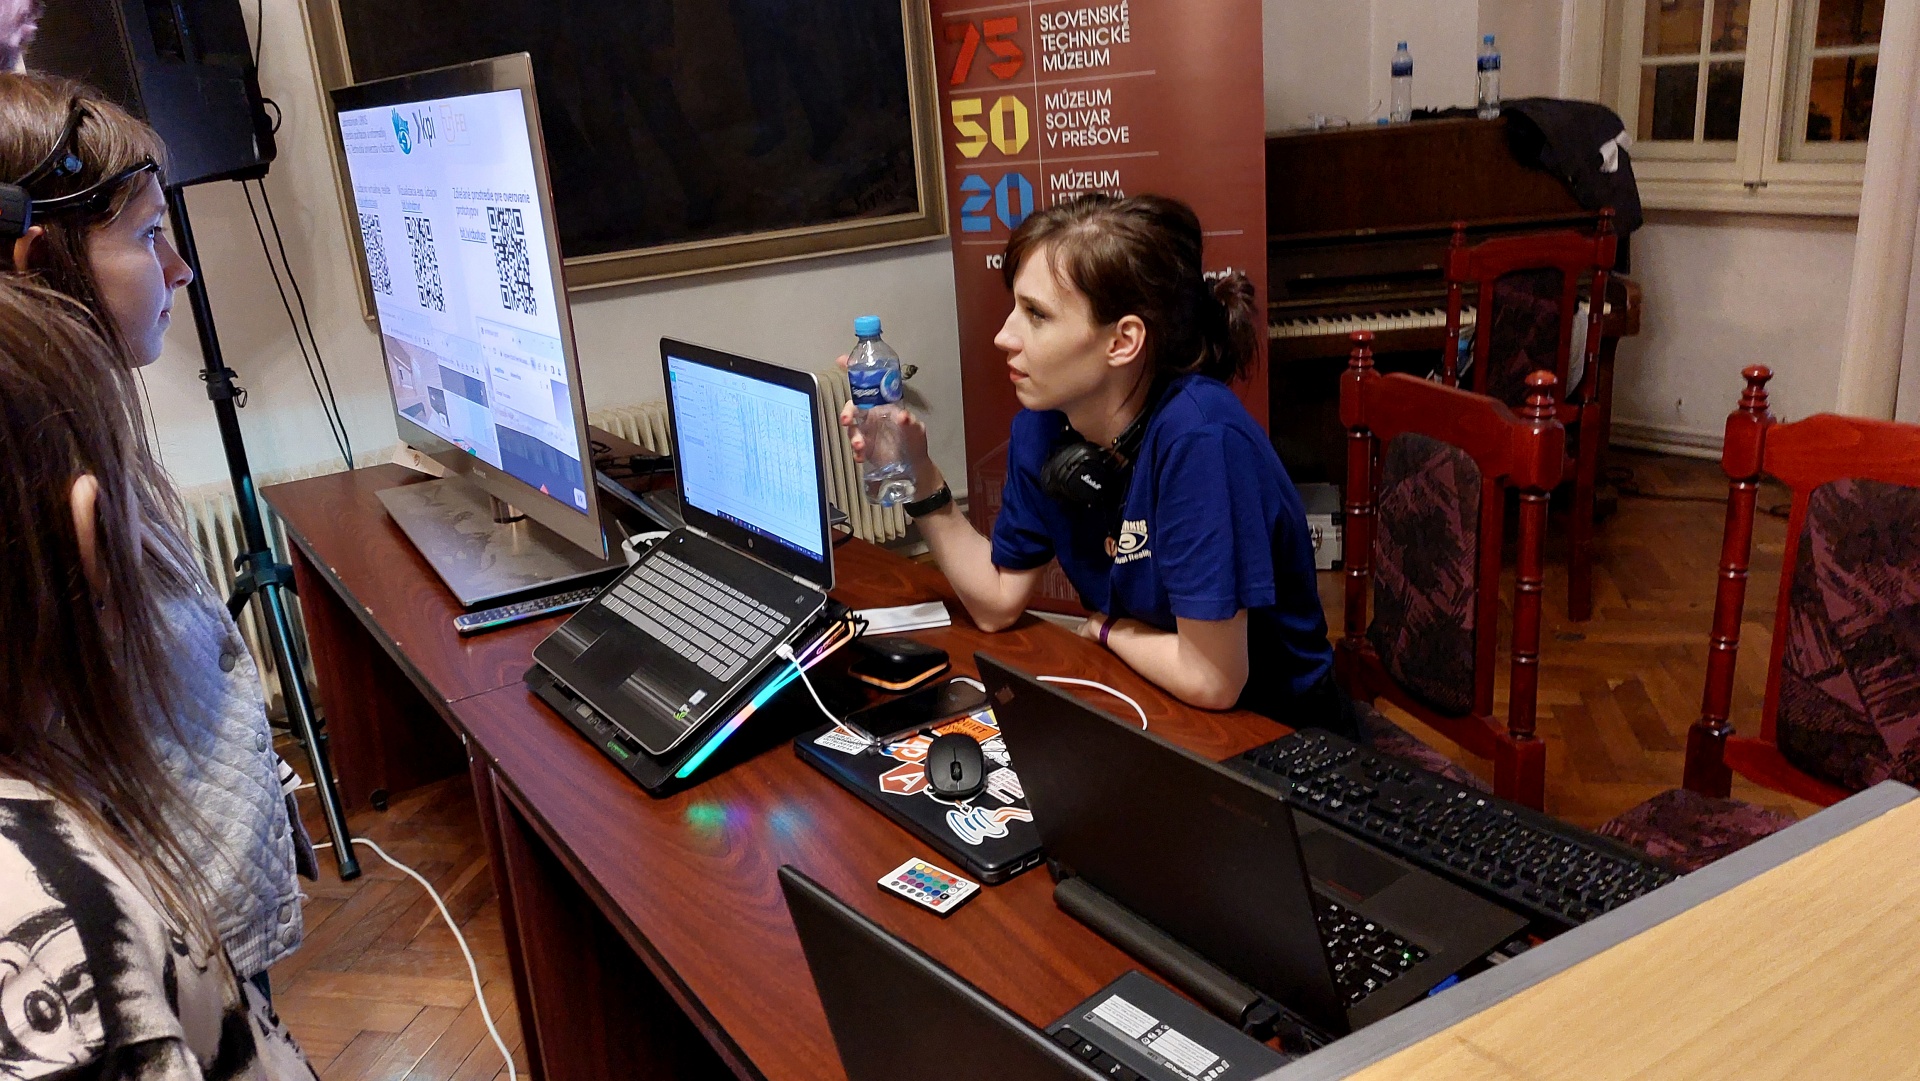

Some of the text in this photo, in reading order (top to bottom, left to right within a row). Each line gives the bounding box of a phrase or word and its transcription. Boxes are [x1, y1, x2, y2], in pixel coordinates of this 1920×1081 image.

[1040, 0, 1129, 32] SLOVENSKÉ
[1040, 22, 1130, 52] TECHNICKÉ
[945, 16, 1025, 86] 75
[1042, 48, 1110, 72] MÚZEUM
[1045, 88, 1112, 111] MÚZEUM
[951, 95, 1029, 158] 50
[1046, 108, 1111, 130] SOLIVAR
[1046, 125, 1130, 149] V PREŠOVE
[1050, 168, 1120, 191] MÚZEUM
[960, 173, 1034, 233] 20
